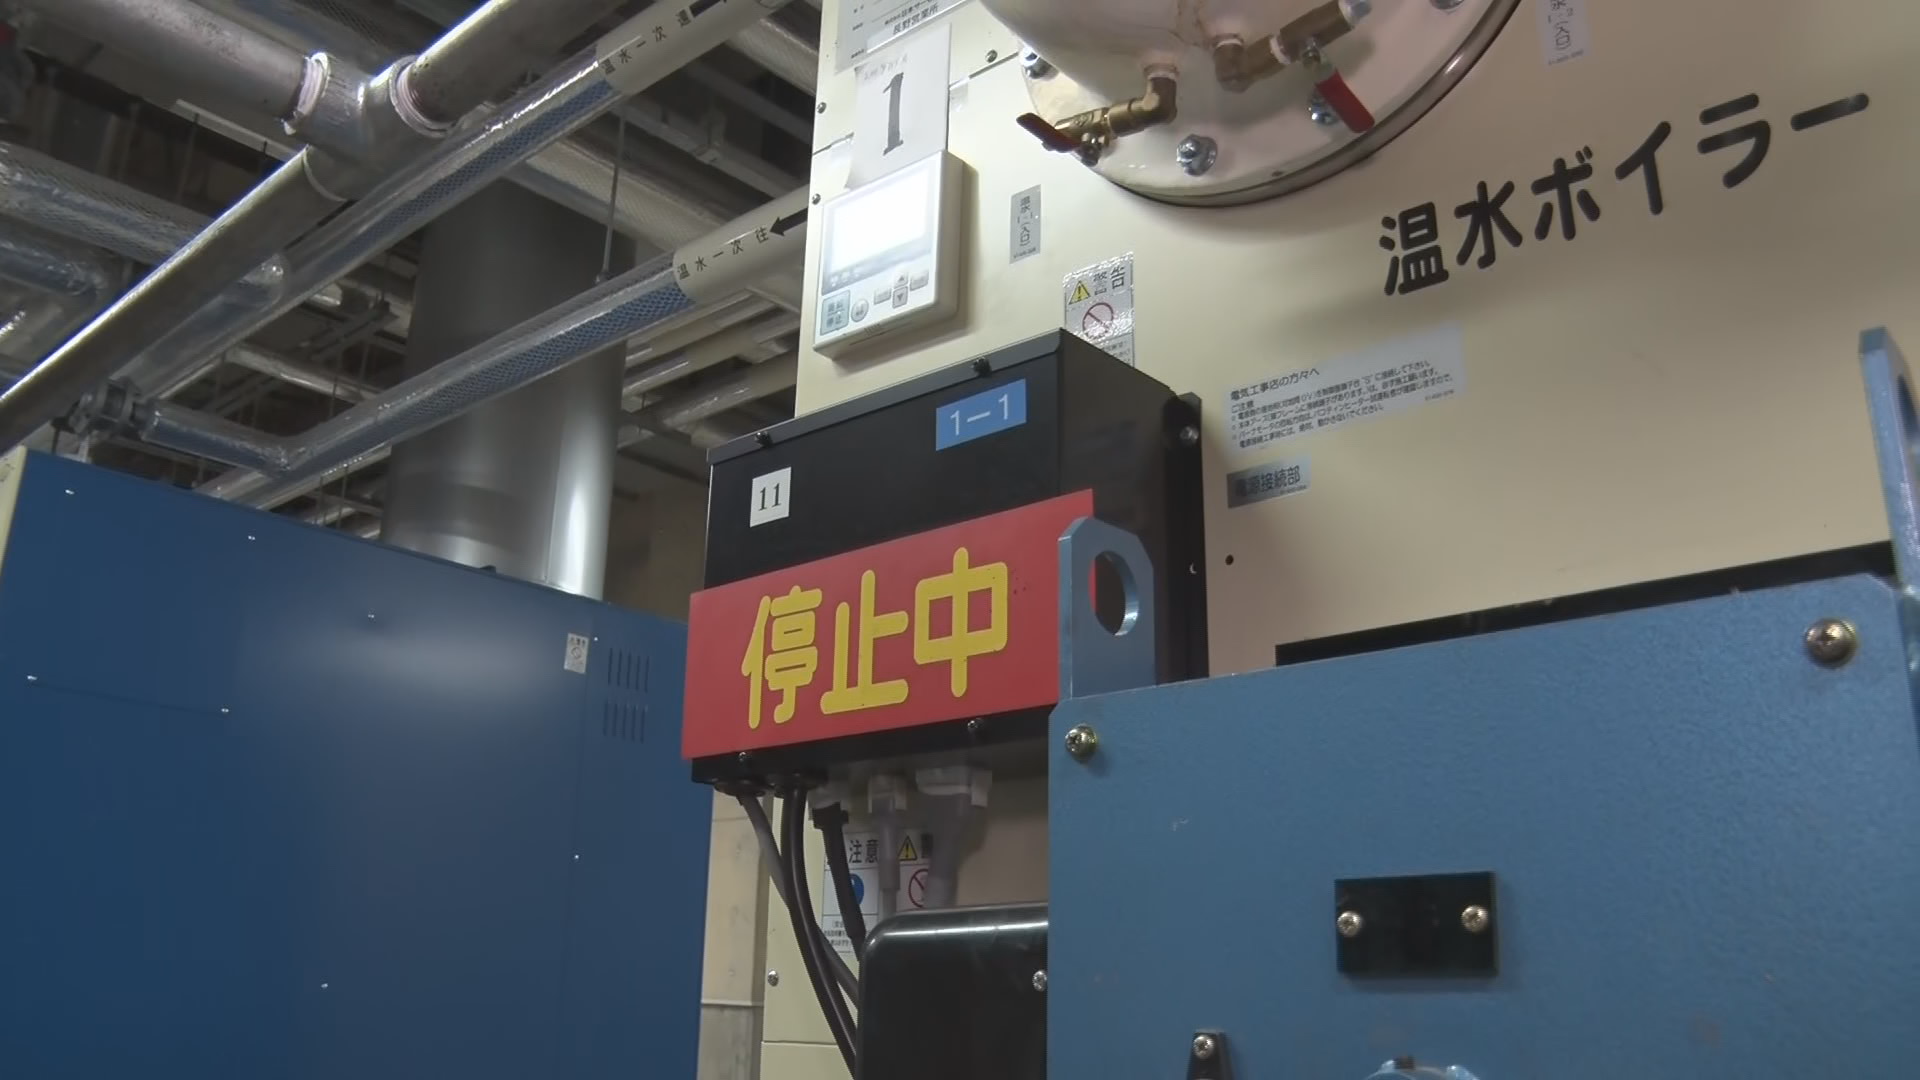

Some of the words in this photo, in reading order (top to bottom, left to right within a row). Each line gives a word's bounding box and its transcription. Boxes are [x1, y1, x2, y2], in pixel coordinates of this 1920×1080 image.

[882, 72, 904, 156] 1
[1378, 93, 1870, 297] 温水ボイラー
[676, 227, 770, 281] 温水一次往
[1093, 265, 1126, 297] 警告
[1230, 367, 1321, 402] 電気工事店の方々へ
[758, 482, 783, 512] 11
[1235, 464, 1301, 497] 源接続部
[741, 546, 1009, 730] 停止中
[848, 838, 879, 864] 注意
